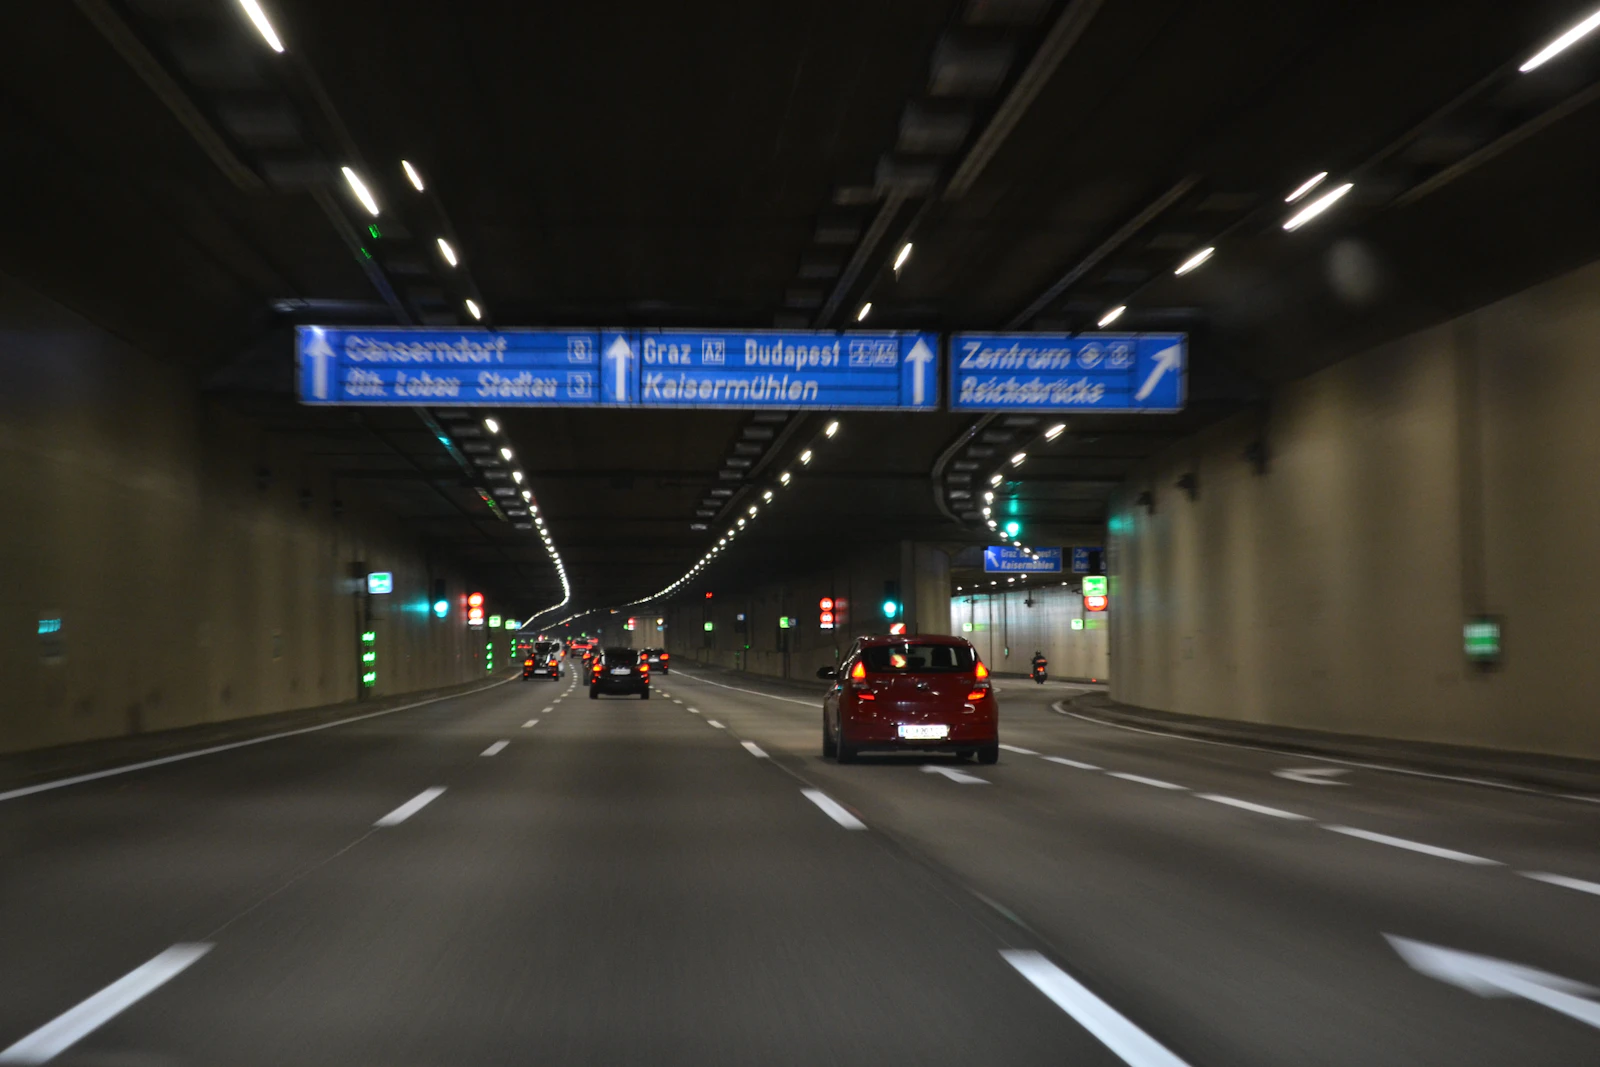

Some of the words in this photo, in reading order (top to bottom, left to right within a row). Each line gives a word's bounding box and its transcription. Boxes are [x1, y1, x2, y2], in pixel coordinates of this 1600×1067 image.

[643, 338, 692, 364] Graz
[703, 340, 724, 362] A2
[745, 339, 840, 371] Budapest
[959, 341, 1071, 369] Zentrum
[394, 370, 461, 396] Lobau
[475, 371, 558, 397] Stadlau
[643, 372, 818, 401] Kaisermühlen
[959, 376, 1105, 403] Reichsbrücke
[1001, 549, 1018, 558] Graz
